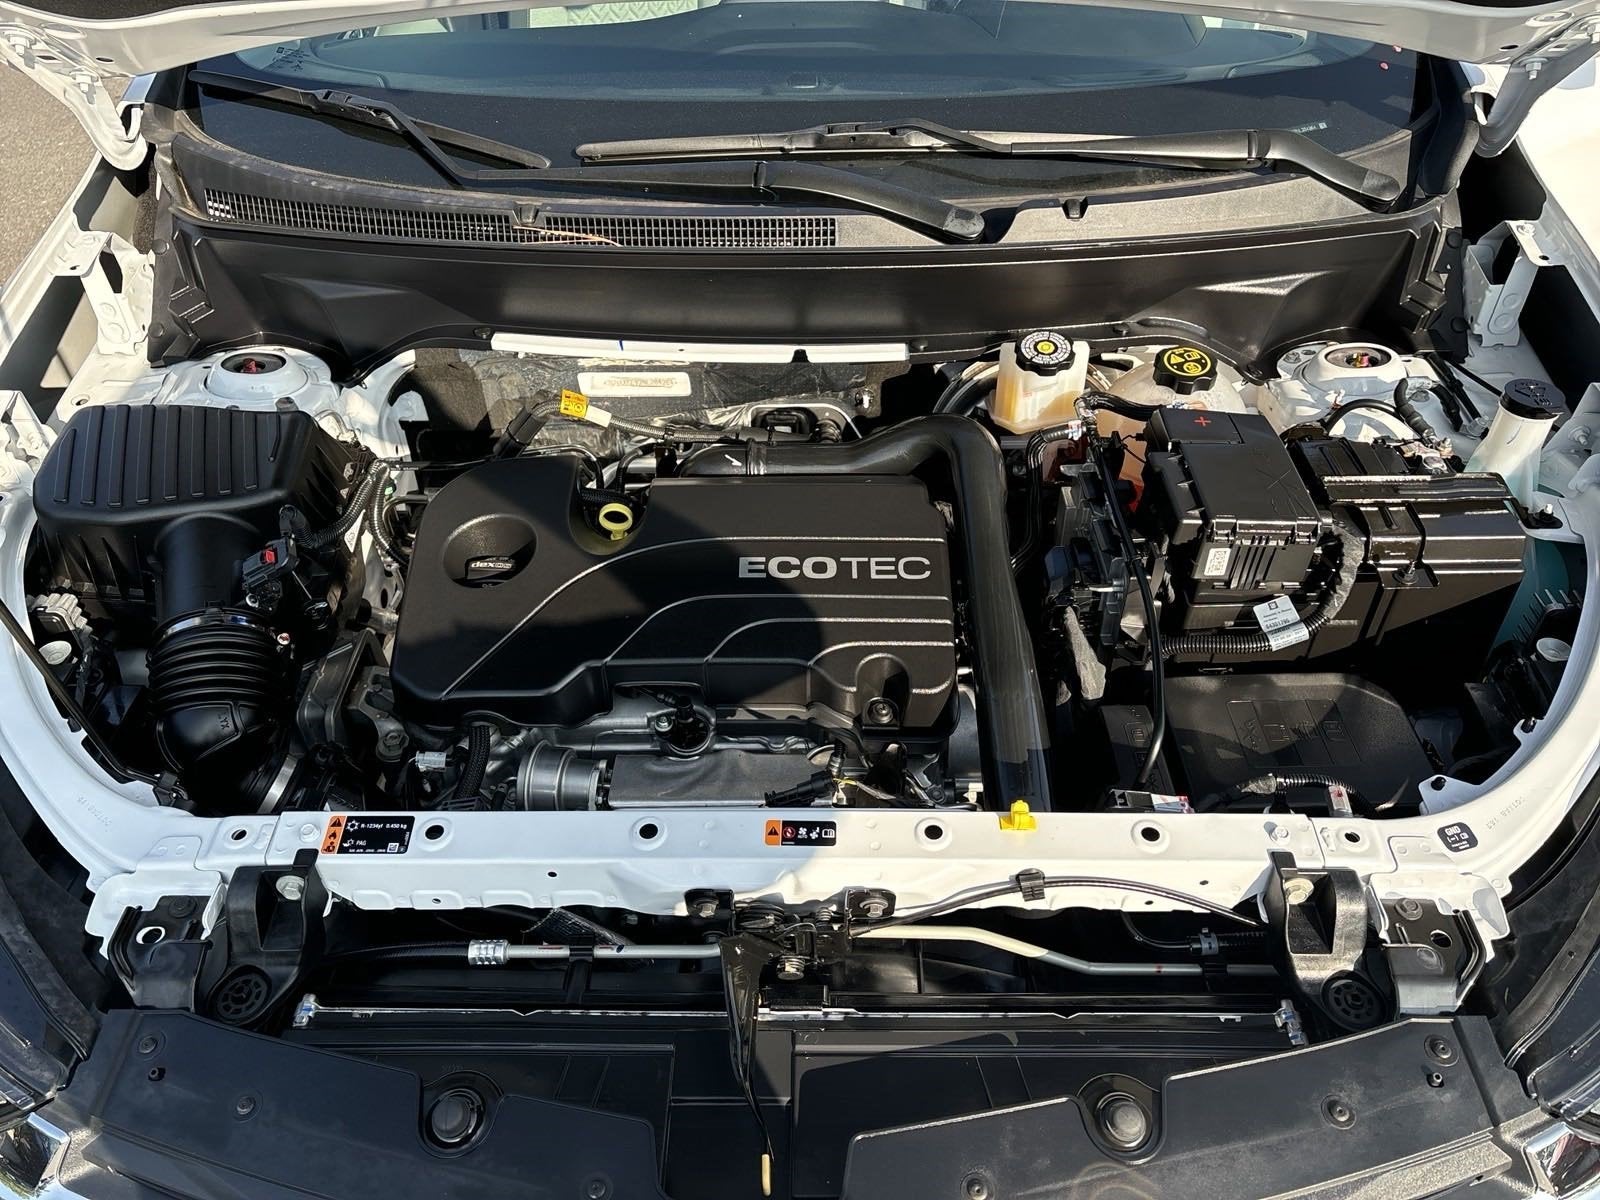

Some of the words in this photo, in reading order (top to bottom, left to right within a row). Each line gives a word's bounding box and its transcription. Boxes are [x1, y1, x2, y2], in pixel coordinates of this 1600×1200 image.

[471, 561, 513, 569] dexos
[738, 556, 932, 580] ECOTEC
[1444, 825, 1461, 836] GND
